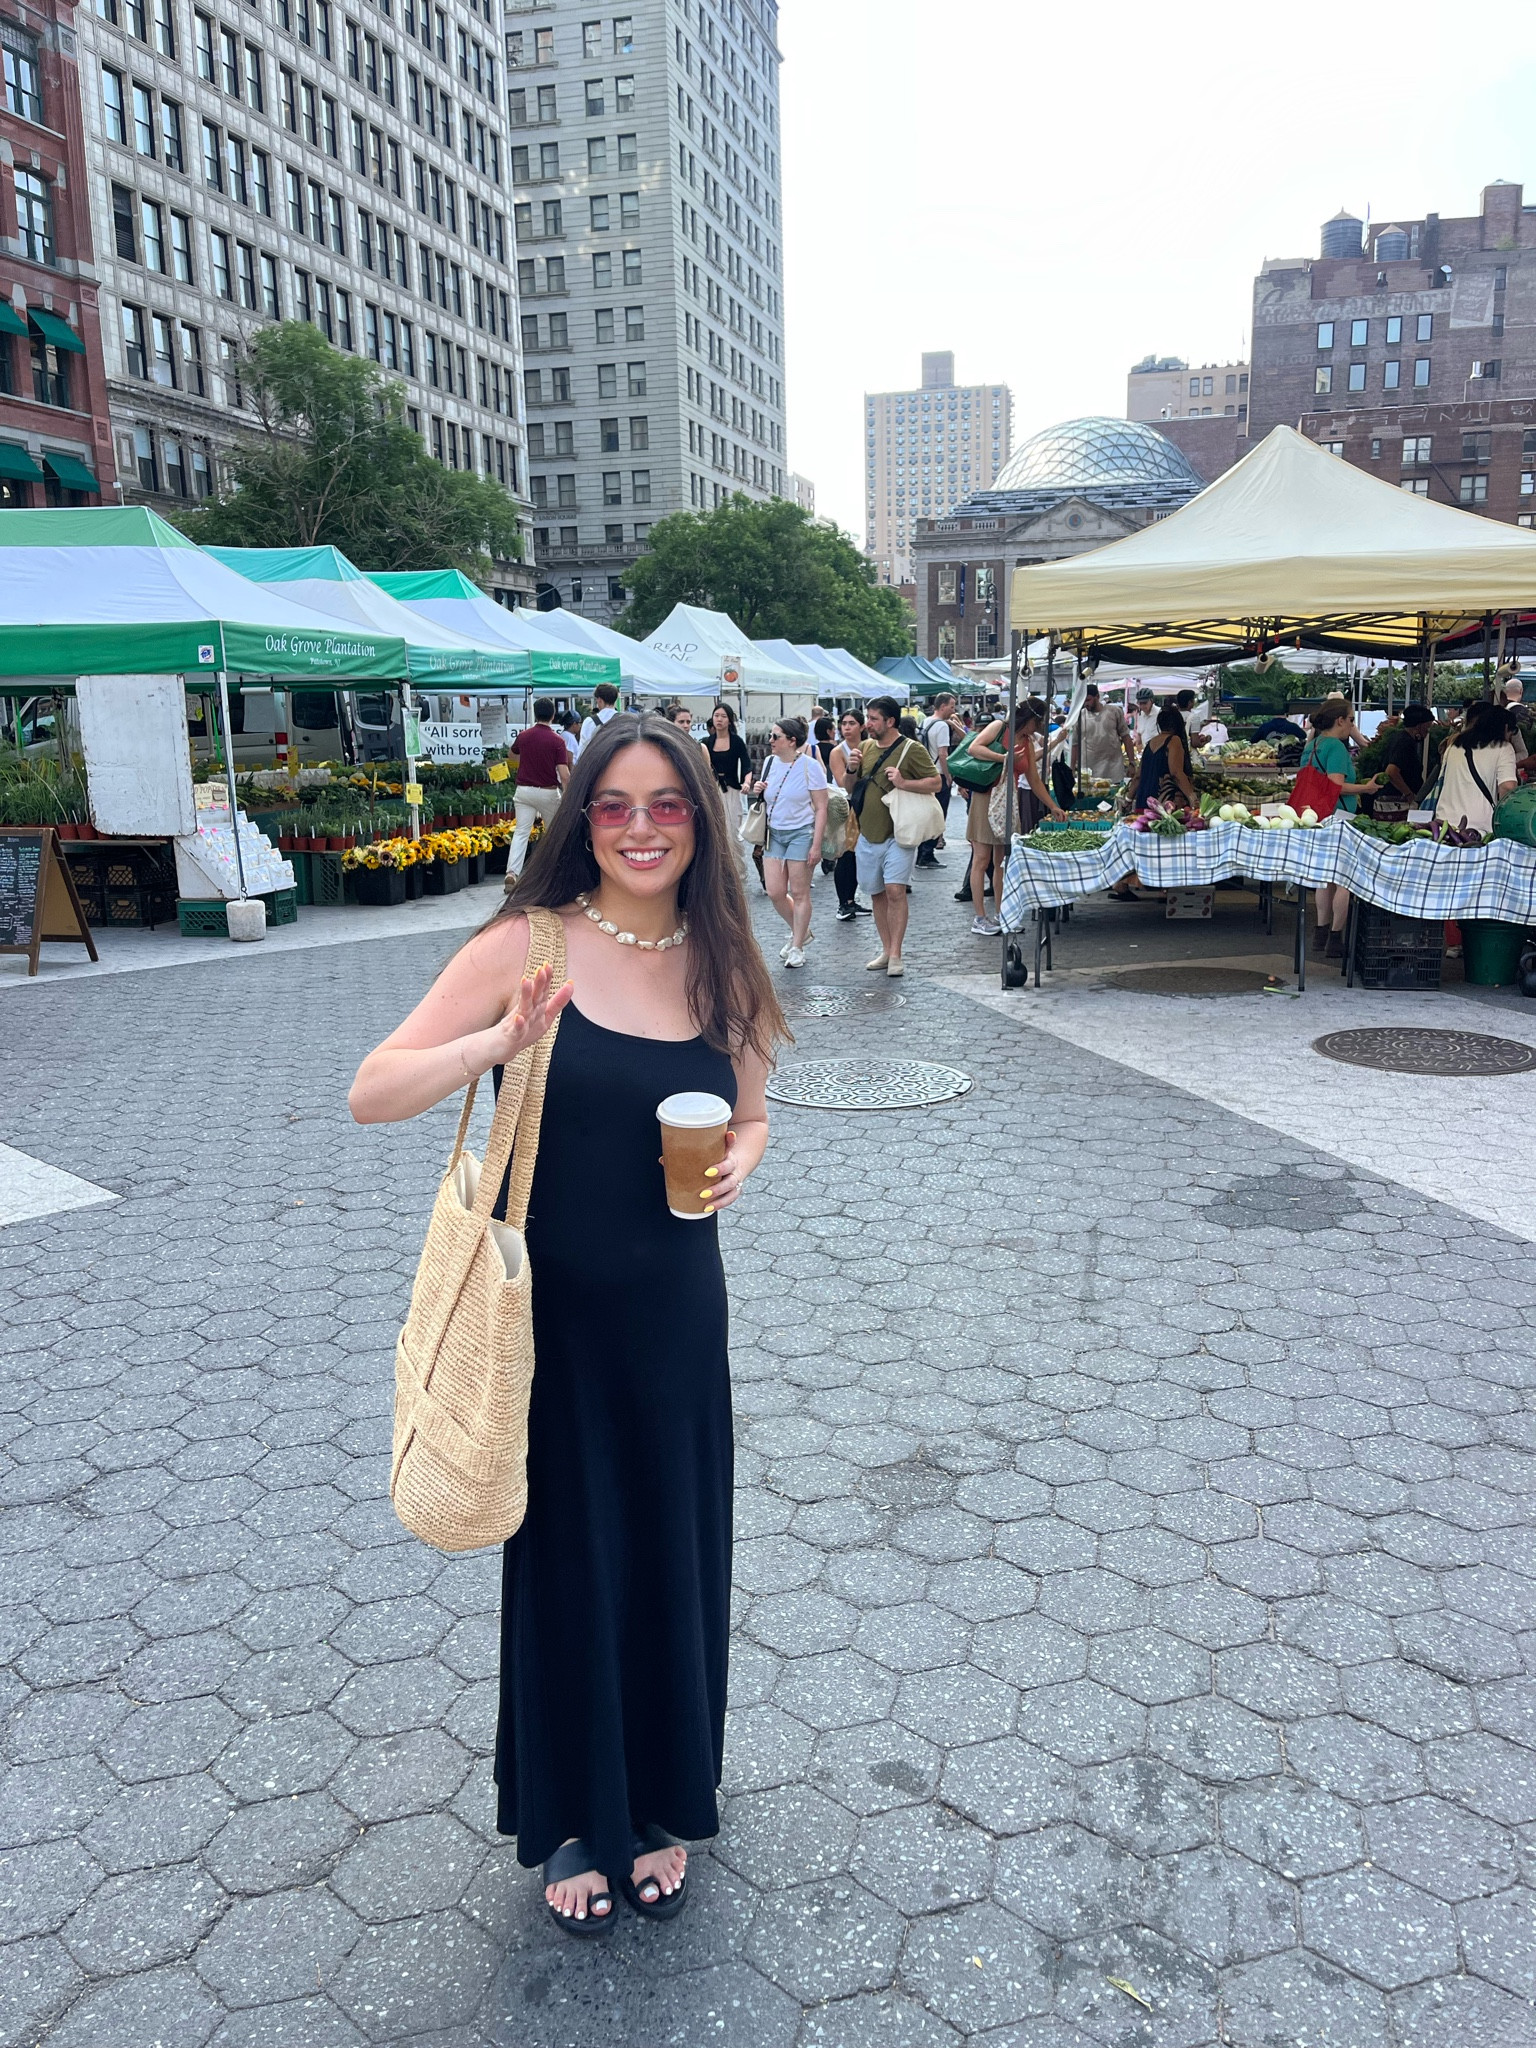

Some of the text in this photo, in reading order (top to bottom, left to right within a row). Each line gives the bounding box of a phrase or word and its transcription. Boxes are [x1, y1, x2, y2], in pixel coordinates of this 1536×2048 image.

[265, 633, 376, 657] Oak Grove Plantation
[652, 642, 698, 653] READ
[429, 652, 515, 674] Oak Grove Plantation
[452, 728, 483, 738] sorr
[690, 723, 707, 731] cru
[425, 743, 486, 756] with brea
